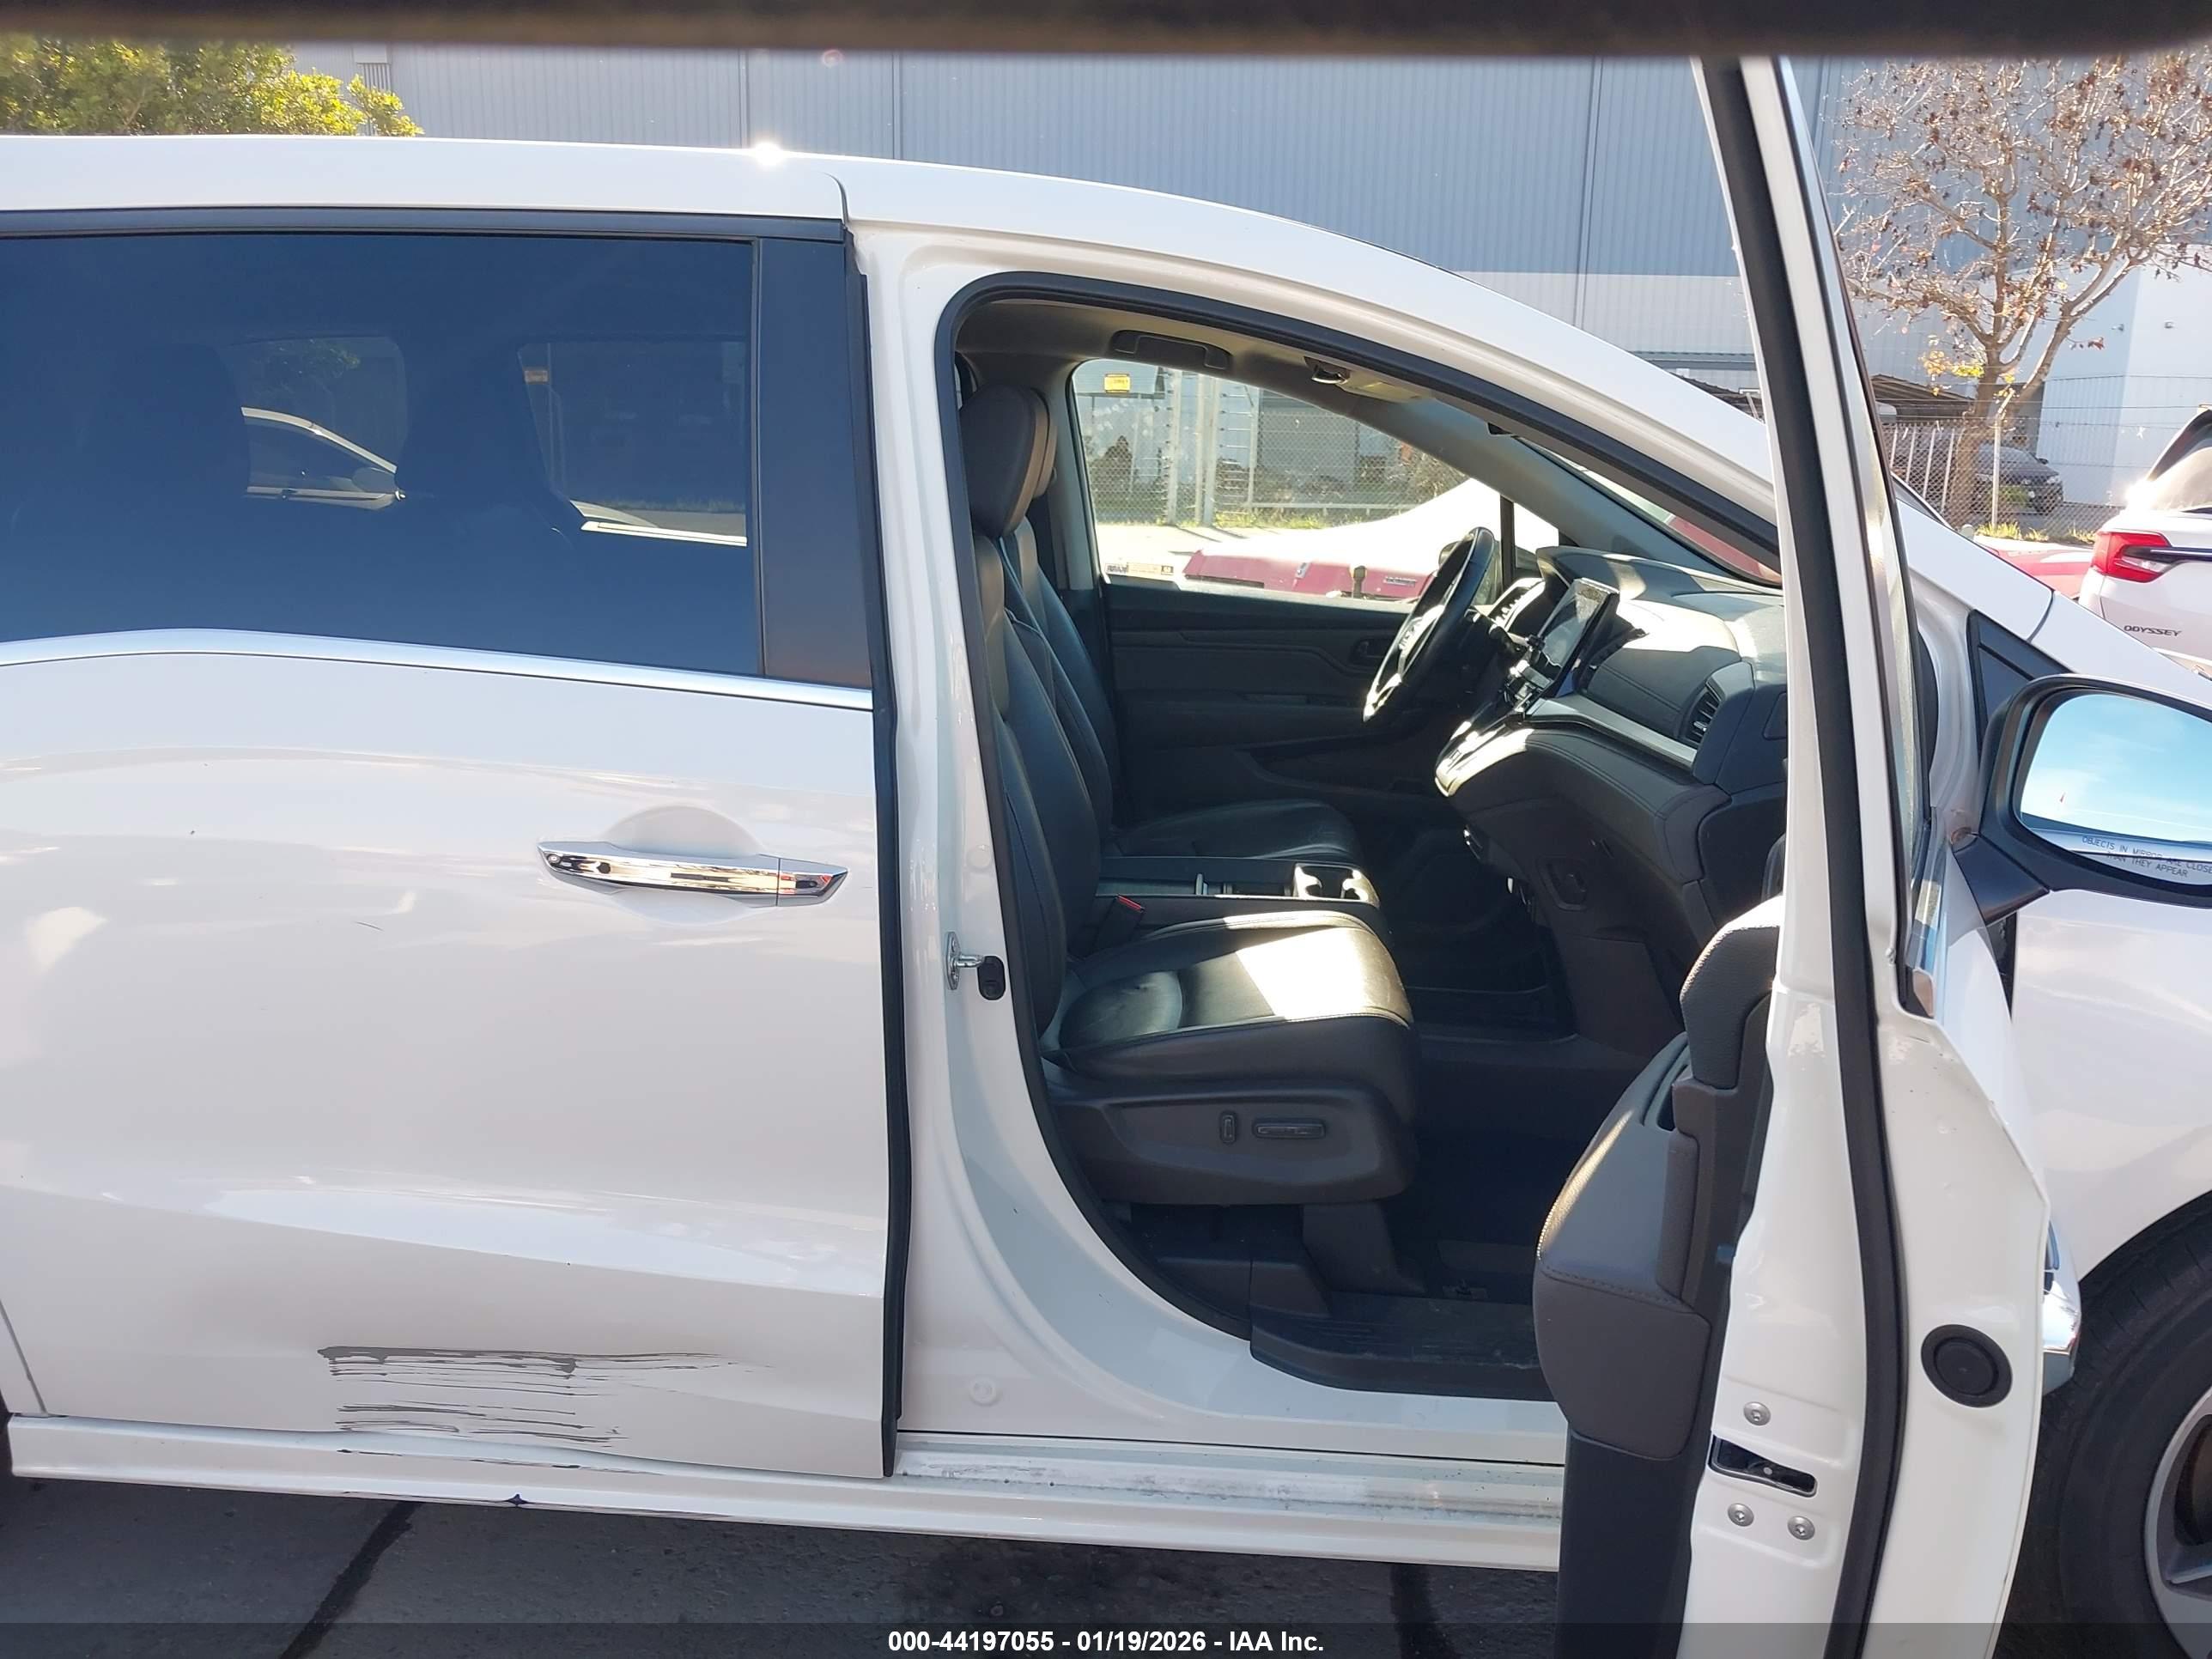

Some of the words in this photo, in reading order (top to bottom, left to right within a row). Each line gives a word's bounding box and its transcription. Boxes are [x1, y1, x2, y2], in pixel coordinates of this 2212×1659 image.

[2124, 625, 2183, 637] ODYSSEY
[2081, 836, 2116, 851] OBJECTS
[2119, 844, 2129, 854] IN
[2132, 858, 2153, 869] THEY
[2155, 863, 2189, 878] APPEAR
